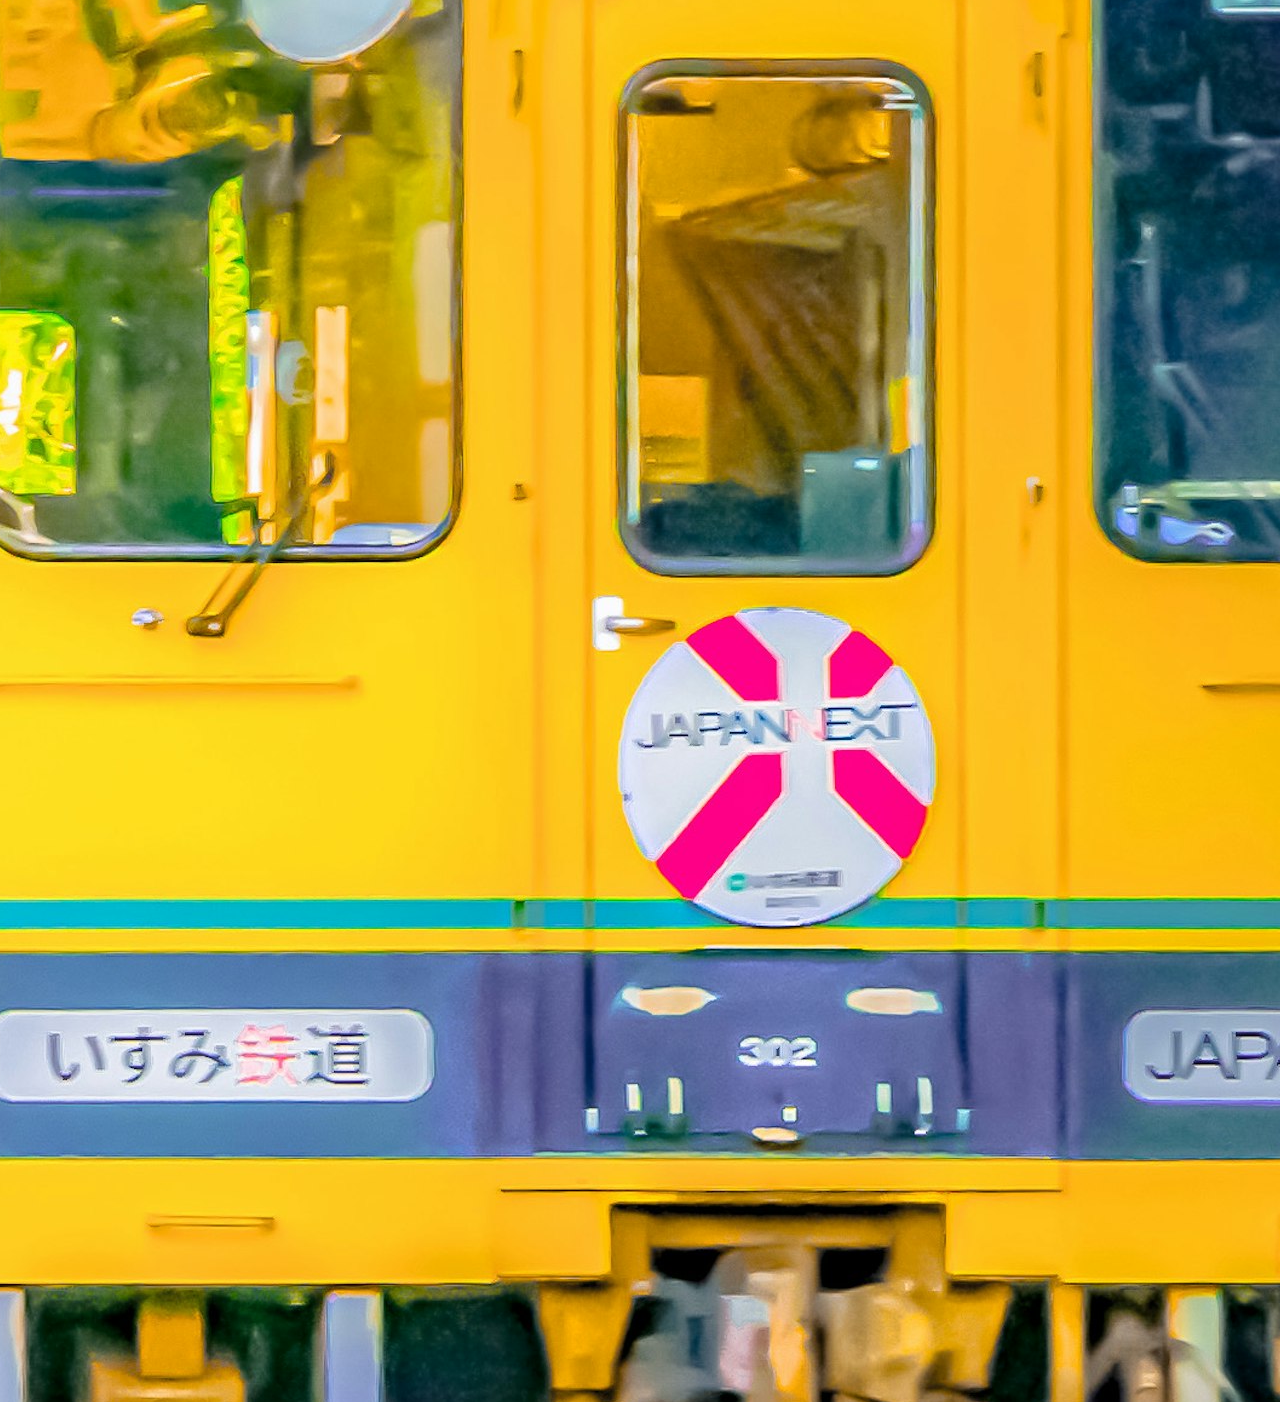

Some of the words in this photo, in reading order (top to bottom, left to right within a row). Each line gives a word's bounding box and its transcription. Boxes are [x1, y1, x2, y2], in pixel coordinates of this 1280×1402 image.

[46, 1024, 370, 1085] いすみ鉄道
[738, 1035, 818, 1067] 302
